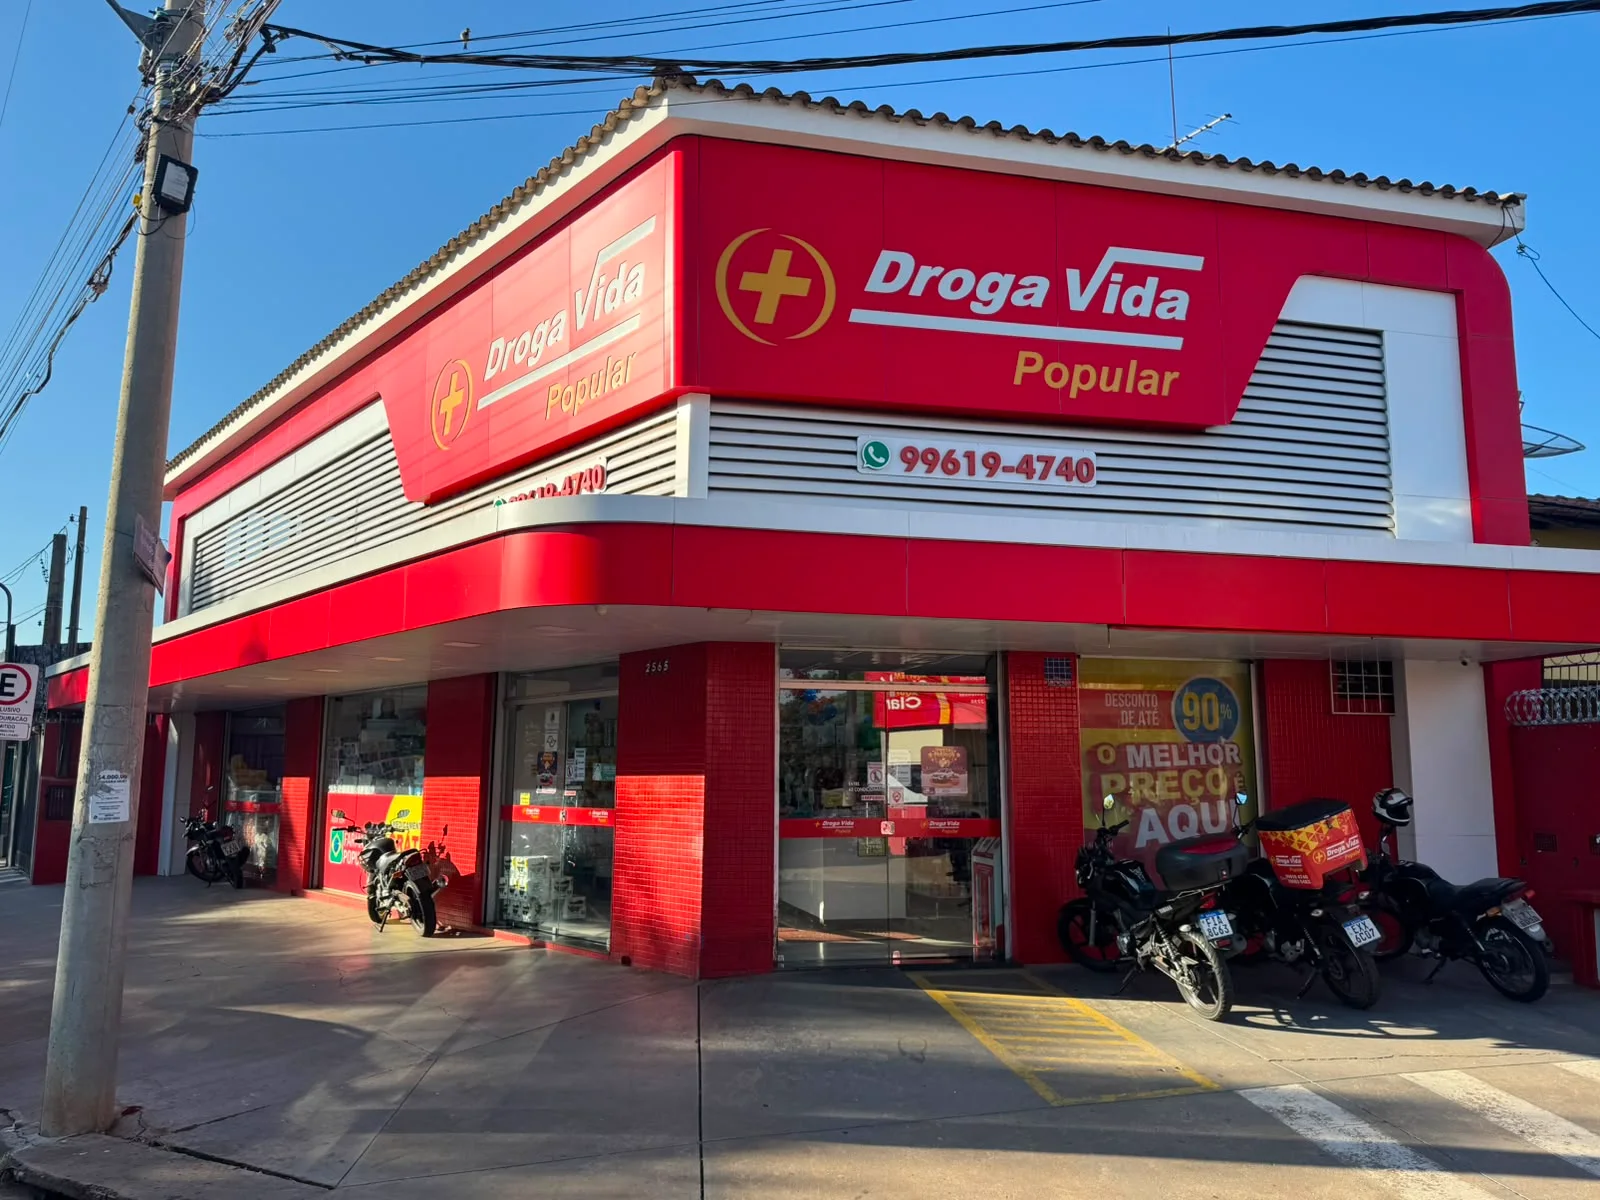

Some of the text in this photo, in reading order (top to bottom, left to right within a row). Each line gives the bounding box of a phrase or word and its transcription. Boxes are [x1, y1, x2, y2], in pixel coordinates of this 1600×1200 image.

[864, 246, 1204, 321] Droga Vida
[483, 214, 656, 382] Droga Vida
[545, 351, 637, 421] Popular
[1013, 350, 1180, 399] Popular
[899, 445, 1095, 484] 99619-4740
[509, 464, 606, 503] 19-4740
[645, 660, 669, 673] 2565
[0, 673, 17, 697] E
[1105, 693, 1159, 709] DESCONTO
[1121, 708, 1159, 726] DE ATÉ
[1097, 743, 1241, 769] O MELHOR
[1101, 767, 1228, 804] PREÇO
[1135, 799, 1241, 848] AQUI
[1326, 834, 1360, 857] Droga Vida
[1205, 915, 1224, 928] FIA
[1207, 923, 1230, 937] 8C63
[1350, 920, 1370, 934] EXX
[1355, 927, 1376, 943] 6C07
